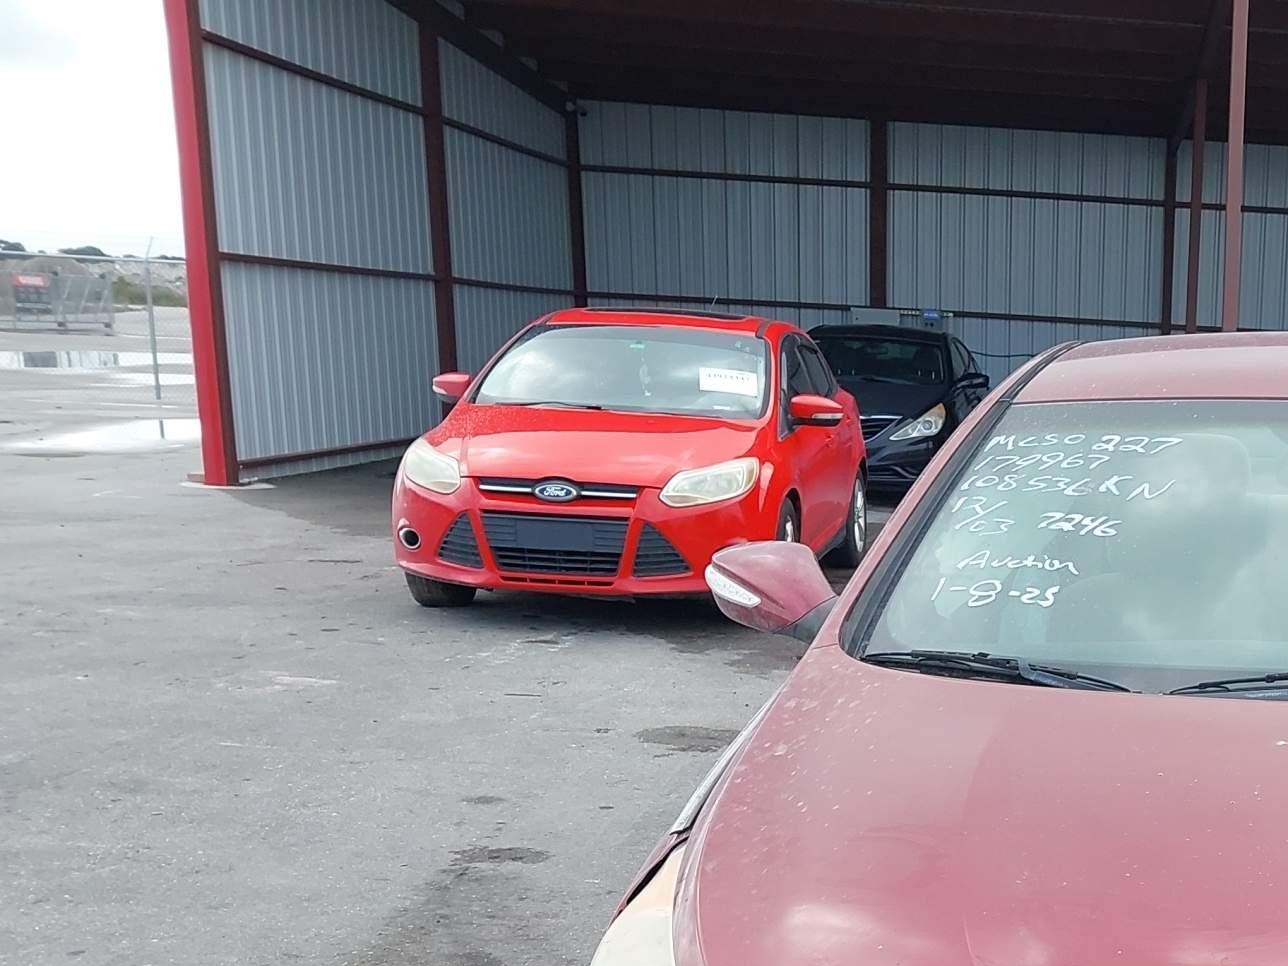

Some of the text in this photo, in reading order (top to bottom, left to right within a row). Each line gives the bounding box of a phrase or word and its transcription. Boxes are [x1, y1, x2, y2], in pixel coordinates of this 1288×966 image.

[1092, 433, 1183, 455] 227
[543, 485, 567, 496] Ford
[957, 550, 1080, 576] Auction
